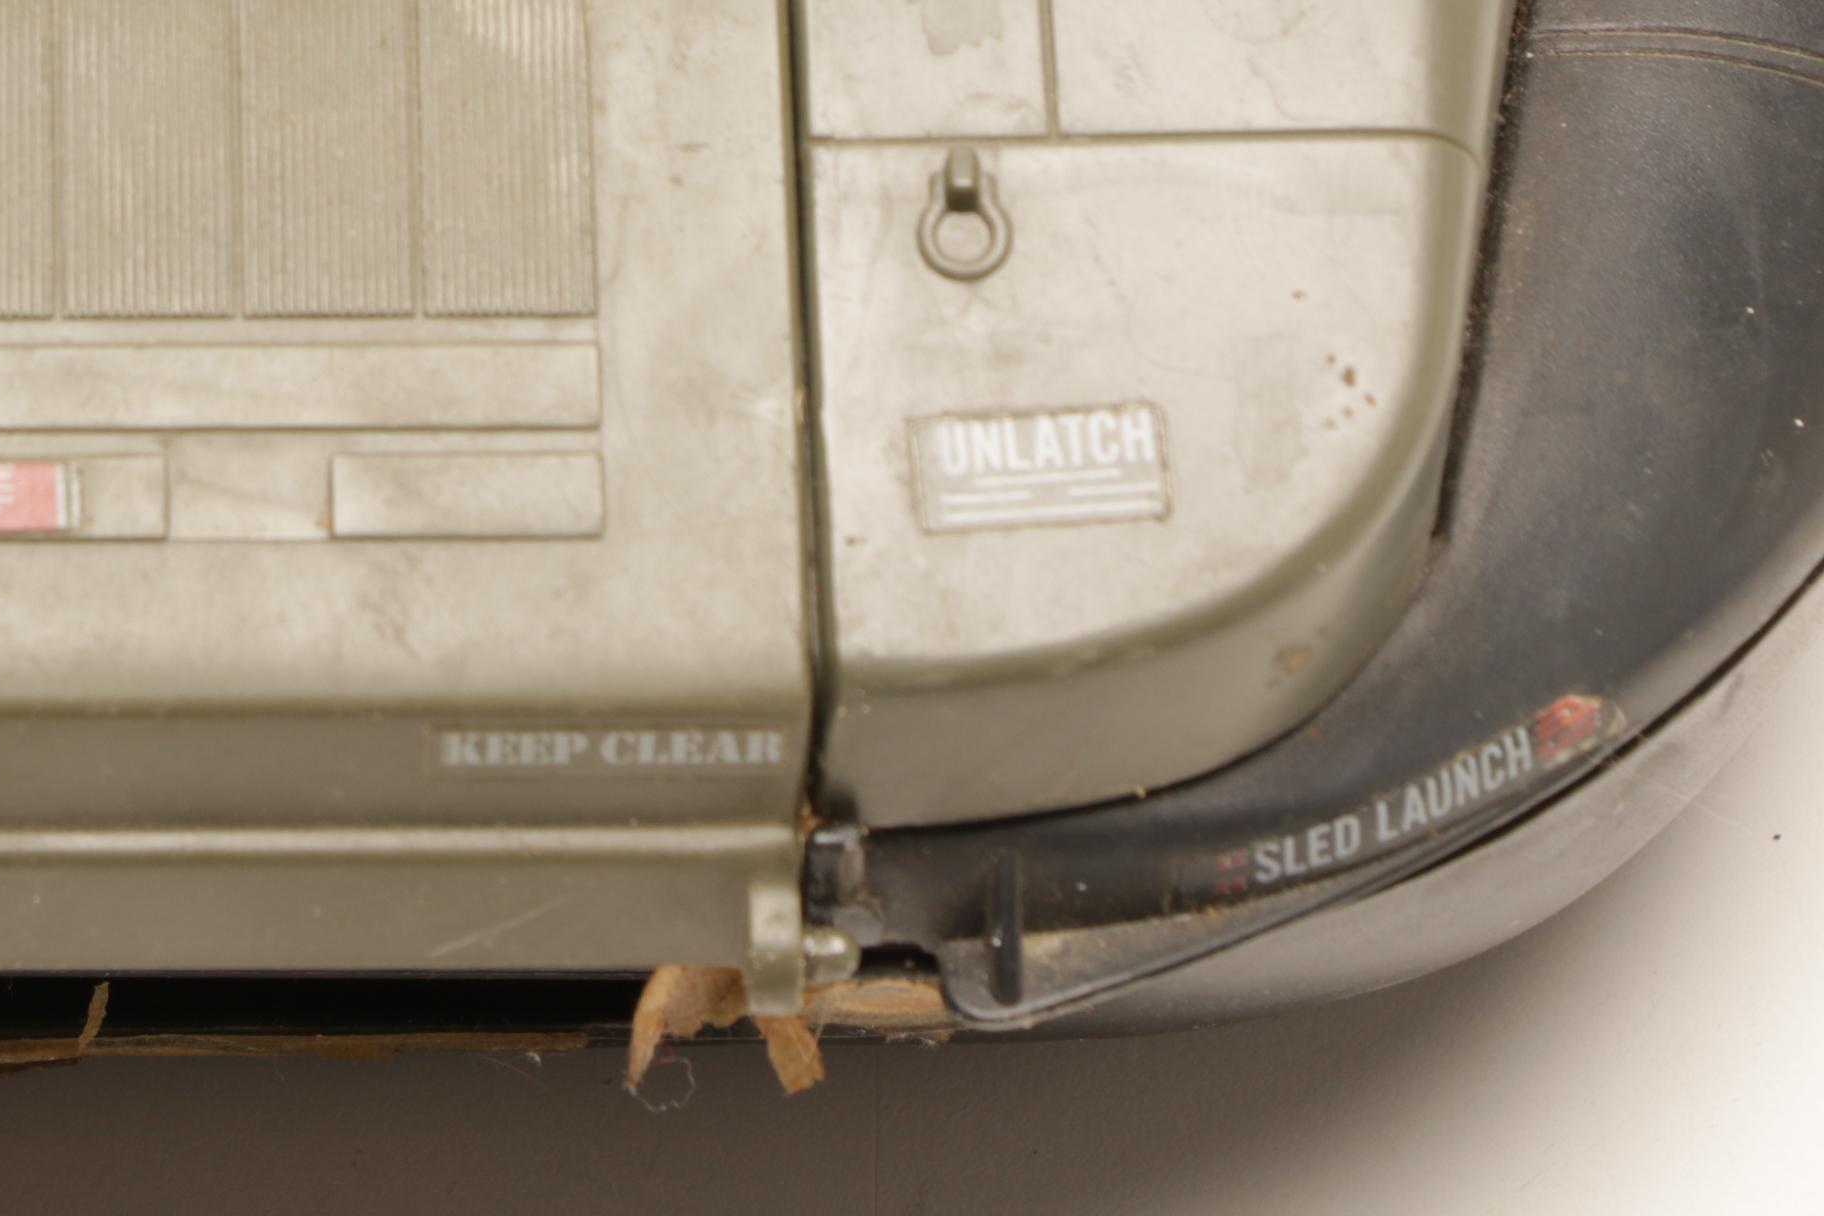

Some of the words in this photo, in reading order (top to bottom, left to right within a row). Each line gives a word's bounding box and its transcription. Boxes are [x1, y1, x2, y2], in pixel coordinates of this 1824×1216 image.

[936, 408, 1155, 476] UNLATCH
[440, 731, 589, 766] KEEP
[598, 730, 782, 765] CLEAR
[1253, 815, 1362, 883] SLED
[1376, 726, 1534, 844] LAUNCH
